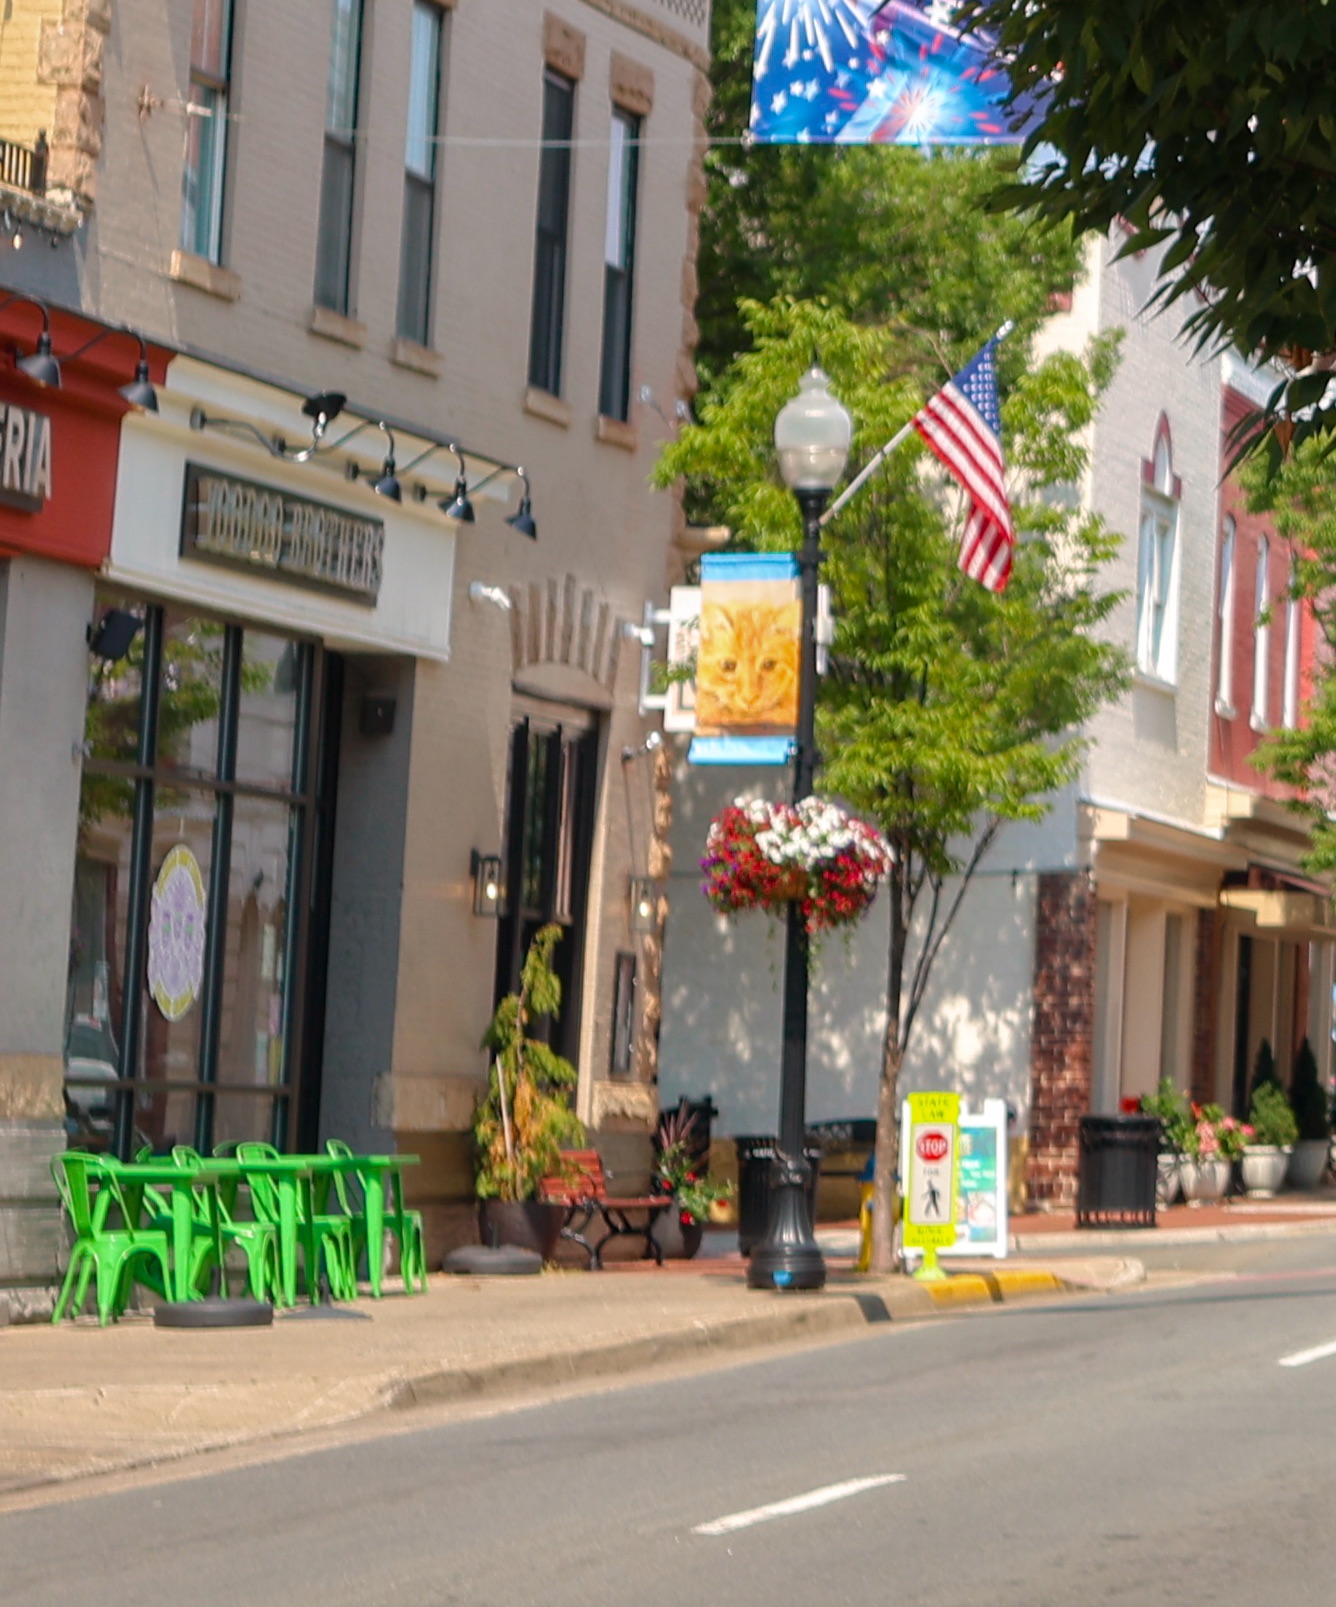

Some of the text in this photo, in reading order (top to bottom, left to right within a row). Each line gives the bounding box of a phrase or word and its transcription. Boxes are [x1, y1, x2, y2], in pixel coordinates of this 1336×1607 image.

[0, 401, 52, 501] RIA
[289, 502, 385, 593] BROTHERS
[918, 1138, 947, 1153] STOP
